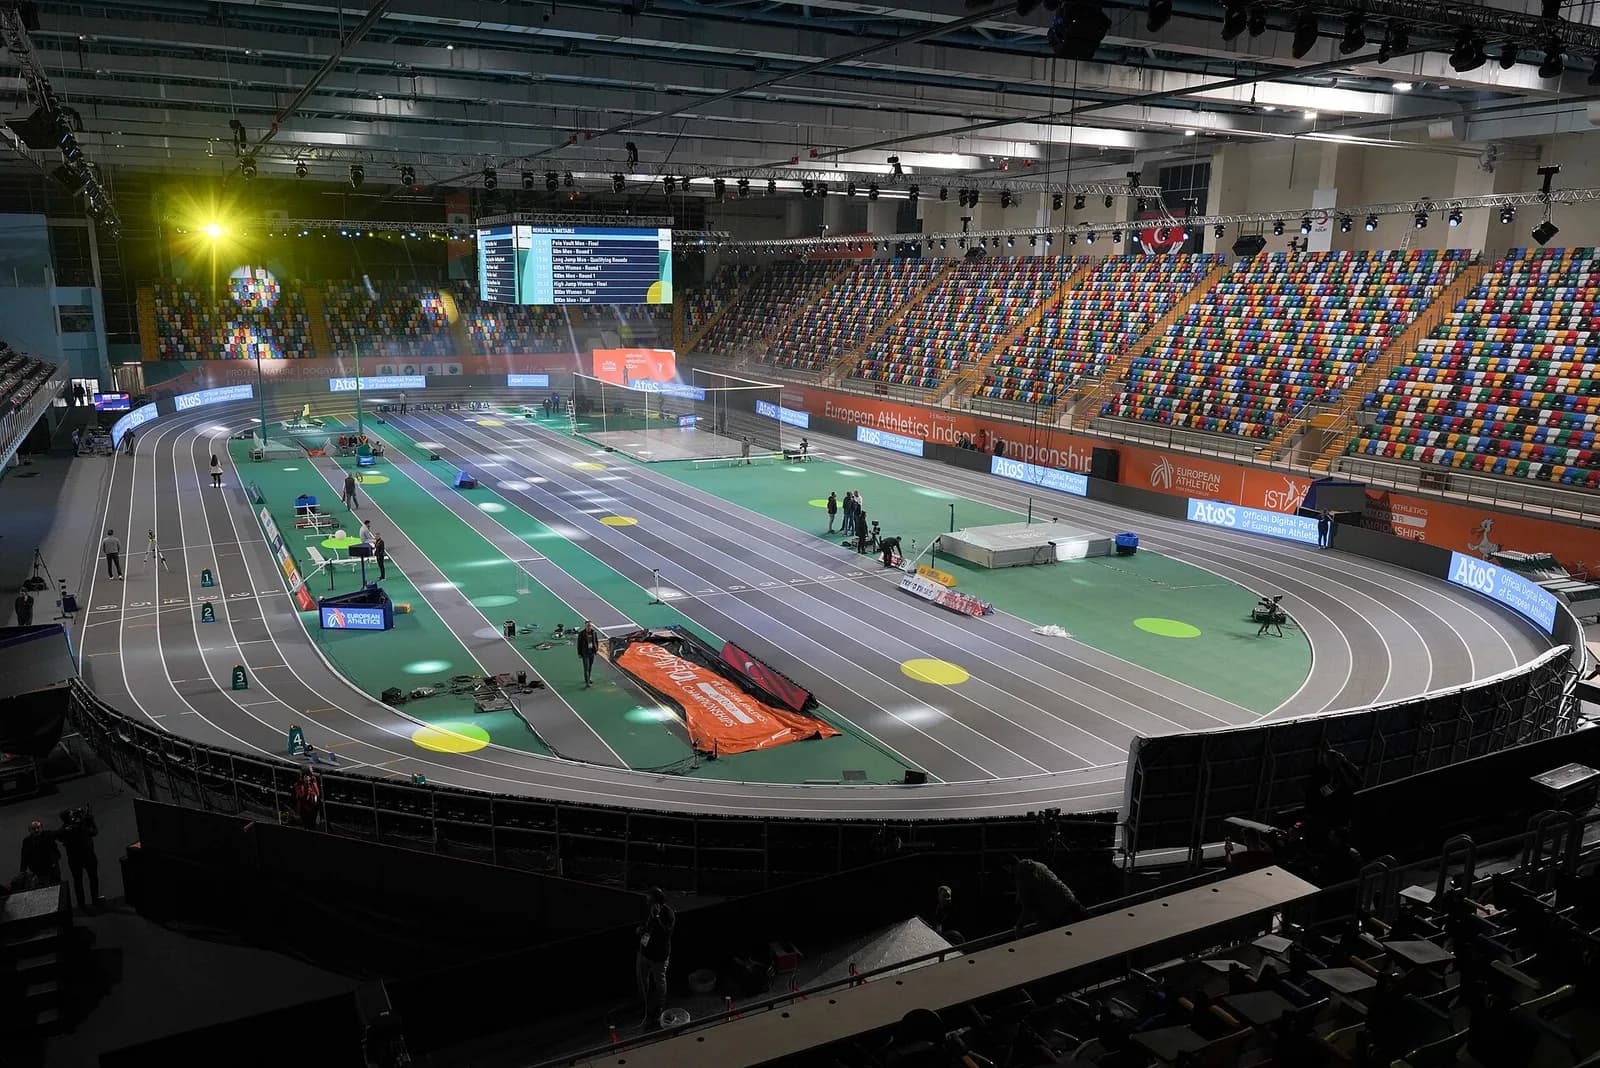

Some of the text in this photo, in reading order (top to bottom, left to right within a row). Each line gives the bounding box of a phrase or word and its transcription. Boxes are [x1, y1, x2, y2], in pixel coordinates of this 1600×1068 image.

[825, 400, 874, 425] European
[877, 411, 929, 437] Athletics
[1176, 467, 1221, 483] EUROPEAN
[1175, 476, 1220, 493] ATHLETICS
[1392, 503, 1428, 516] ATHLETICS
[1242, 510, 1268, 522] Official
[1271, 515, 1297, 528] Digital
[1252, 522, 1287, 535] European
[204, 573, 209, 582] 1
[1498, 588, 1506, 598] of
[1506, 590, 1531, 611] European
[1501, 574, 1554, 613] Official Digital Partner
[204, 607, 212, 617] 2
[236, 671, 244, 682] 3
[293, 733, 302, 745] 4
